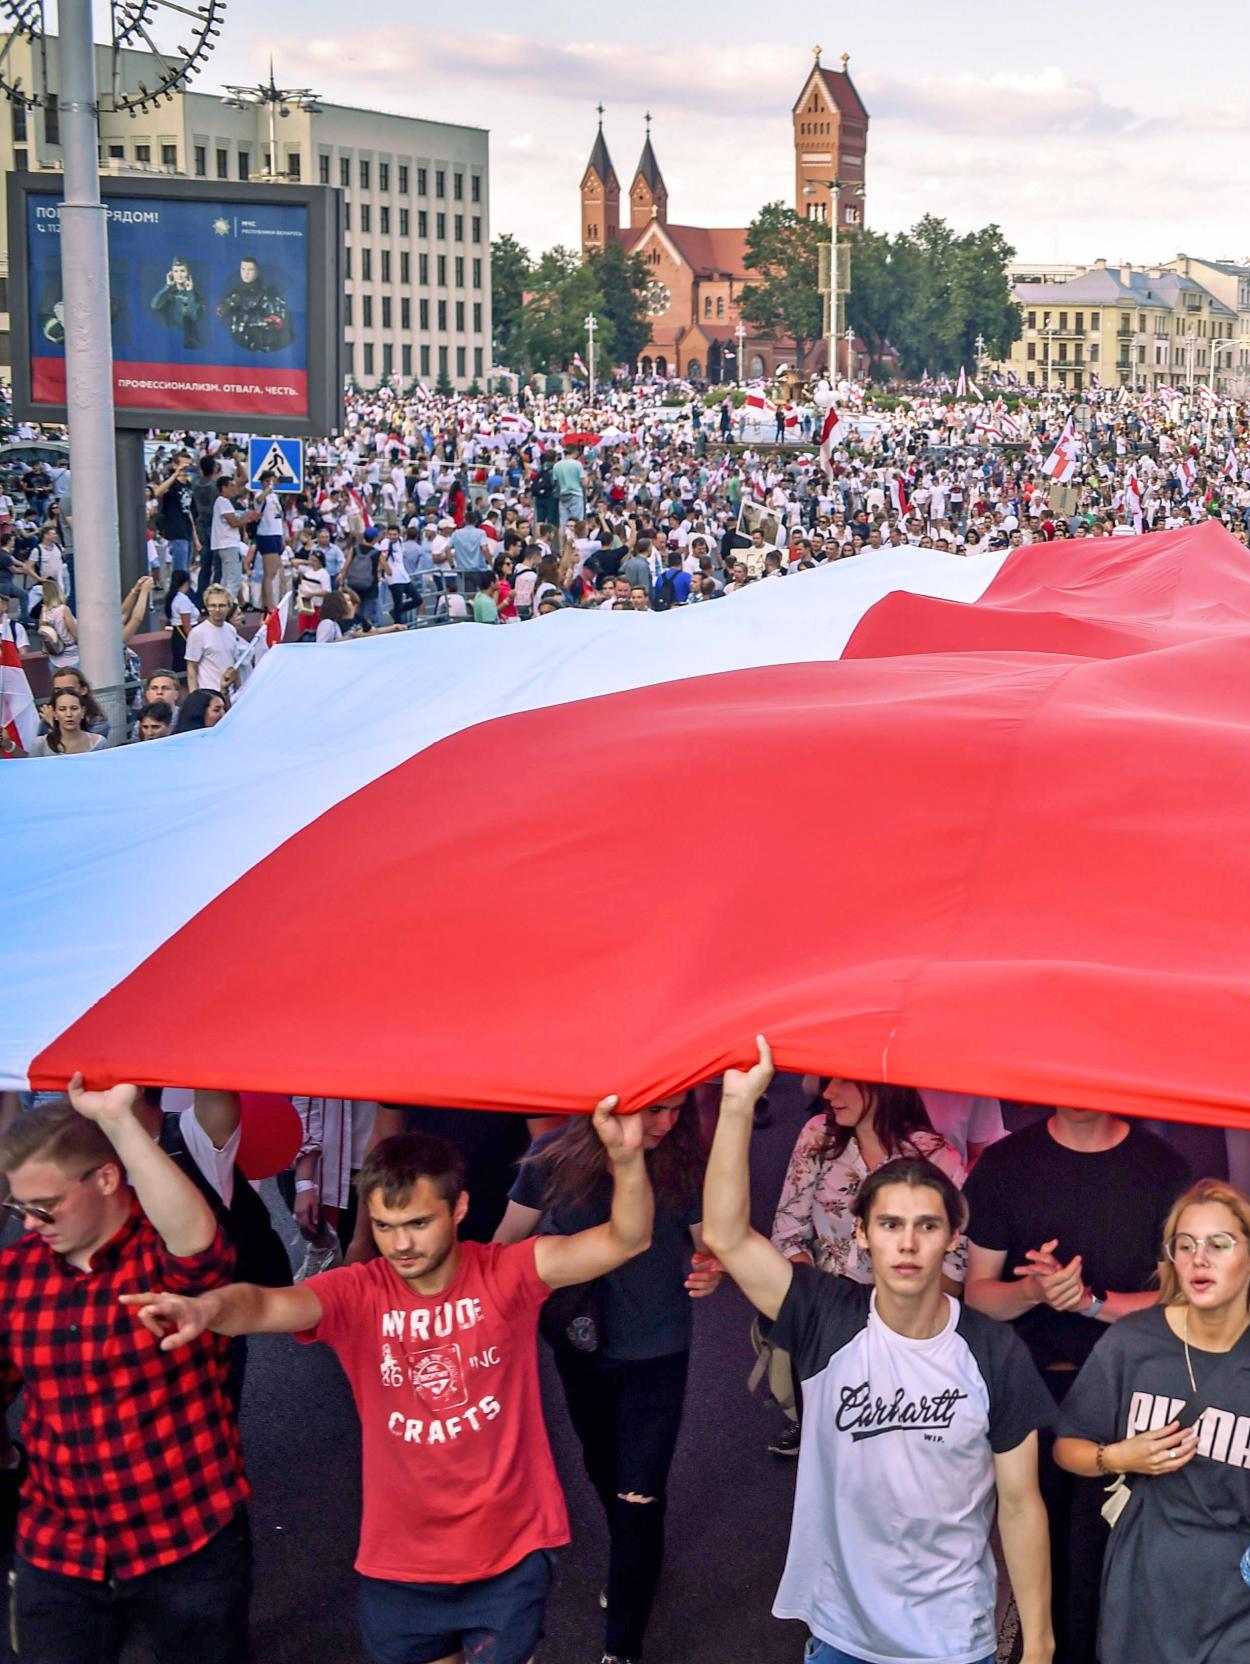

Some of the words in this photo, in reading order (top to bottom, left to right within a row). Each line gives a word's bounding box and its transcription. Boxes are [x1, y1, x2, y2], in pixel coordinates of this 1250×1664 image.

[118, 379, 221, 393] ПРОФЕССИОНАЛИЗМ.
[223, 384, 263, 394] ОТВАГА.
[265, 386, 298, 396] ЧЕСТЬ.
[388, 1395, 501, 1444] CRAFTS
[835, 1381, 968, 1432] Carhartt
